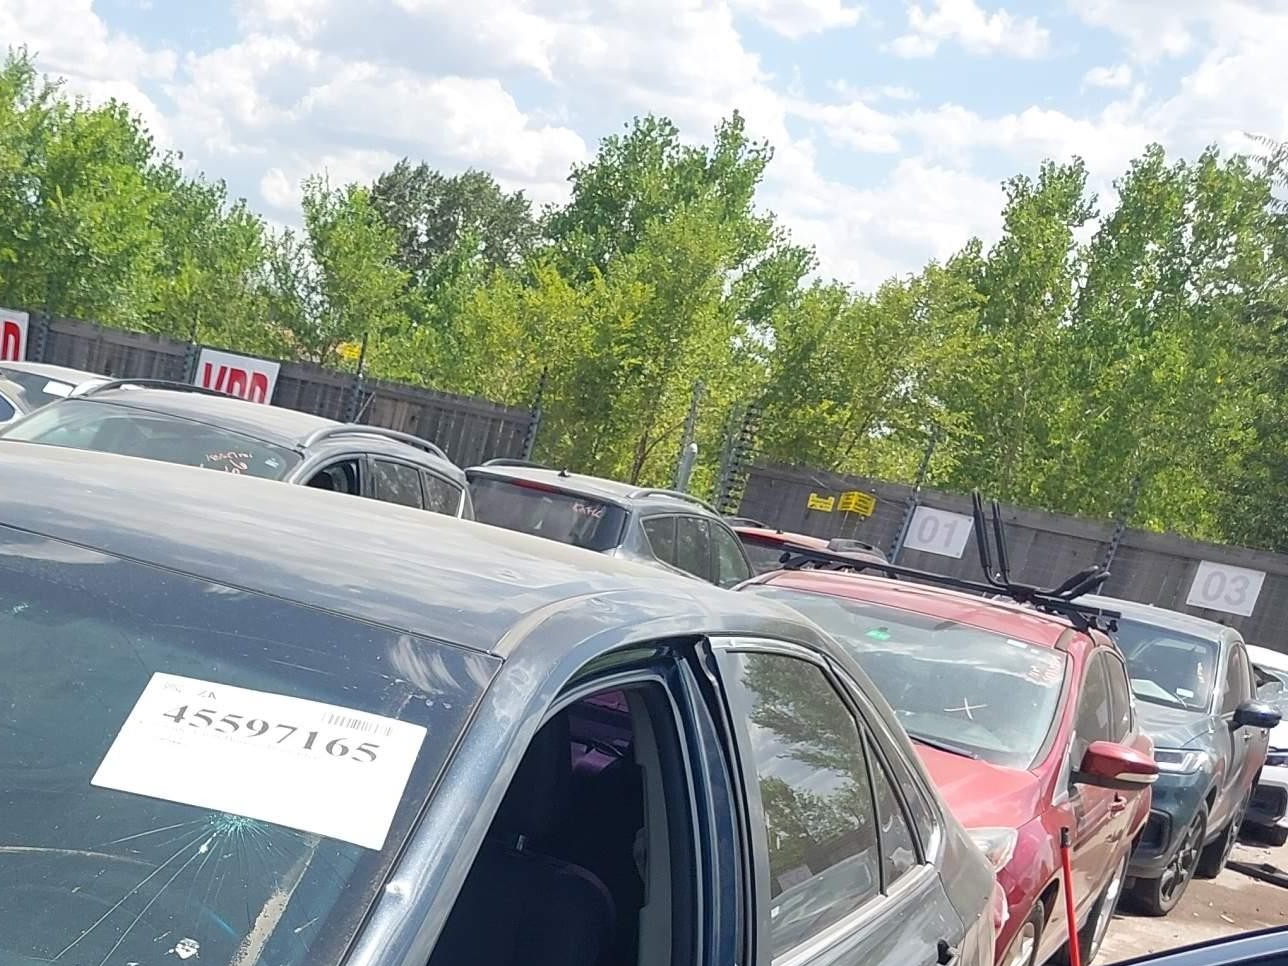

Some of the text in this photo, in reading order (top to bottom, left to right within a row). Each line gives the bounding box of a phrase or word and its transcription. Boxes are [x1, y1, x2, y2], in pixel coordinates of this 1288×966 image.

[917, 515, 958, 548] 01
[1201, 571, 1250, 606] 03
[163, 704, 380, 763] 45597165
